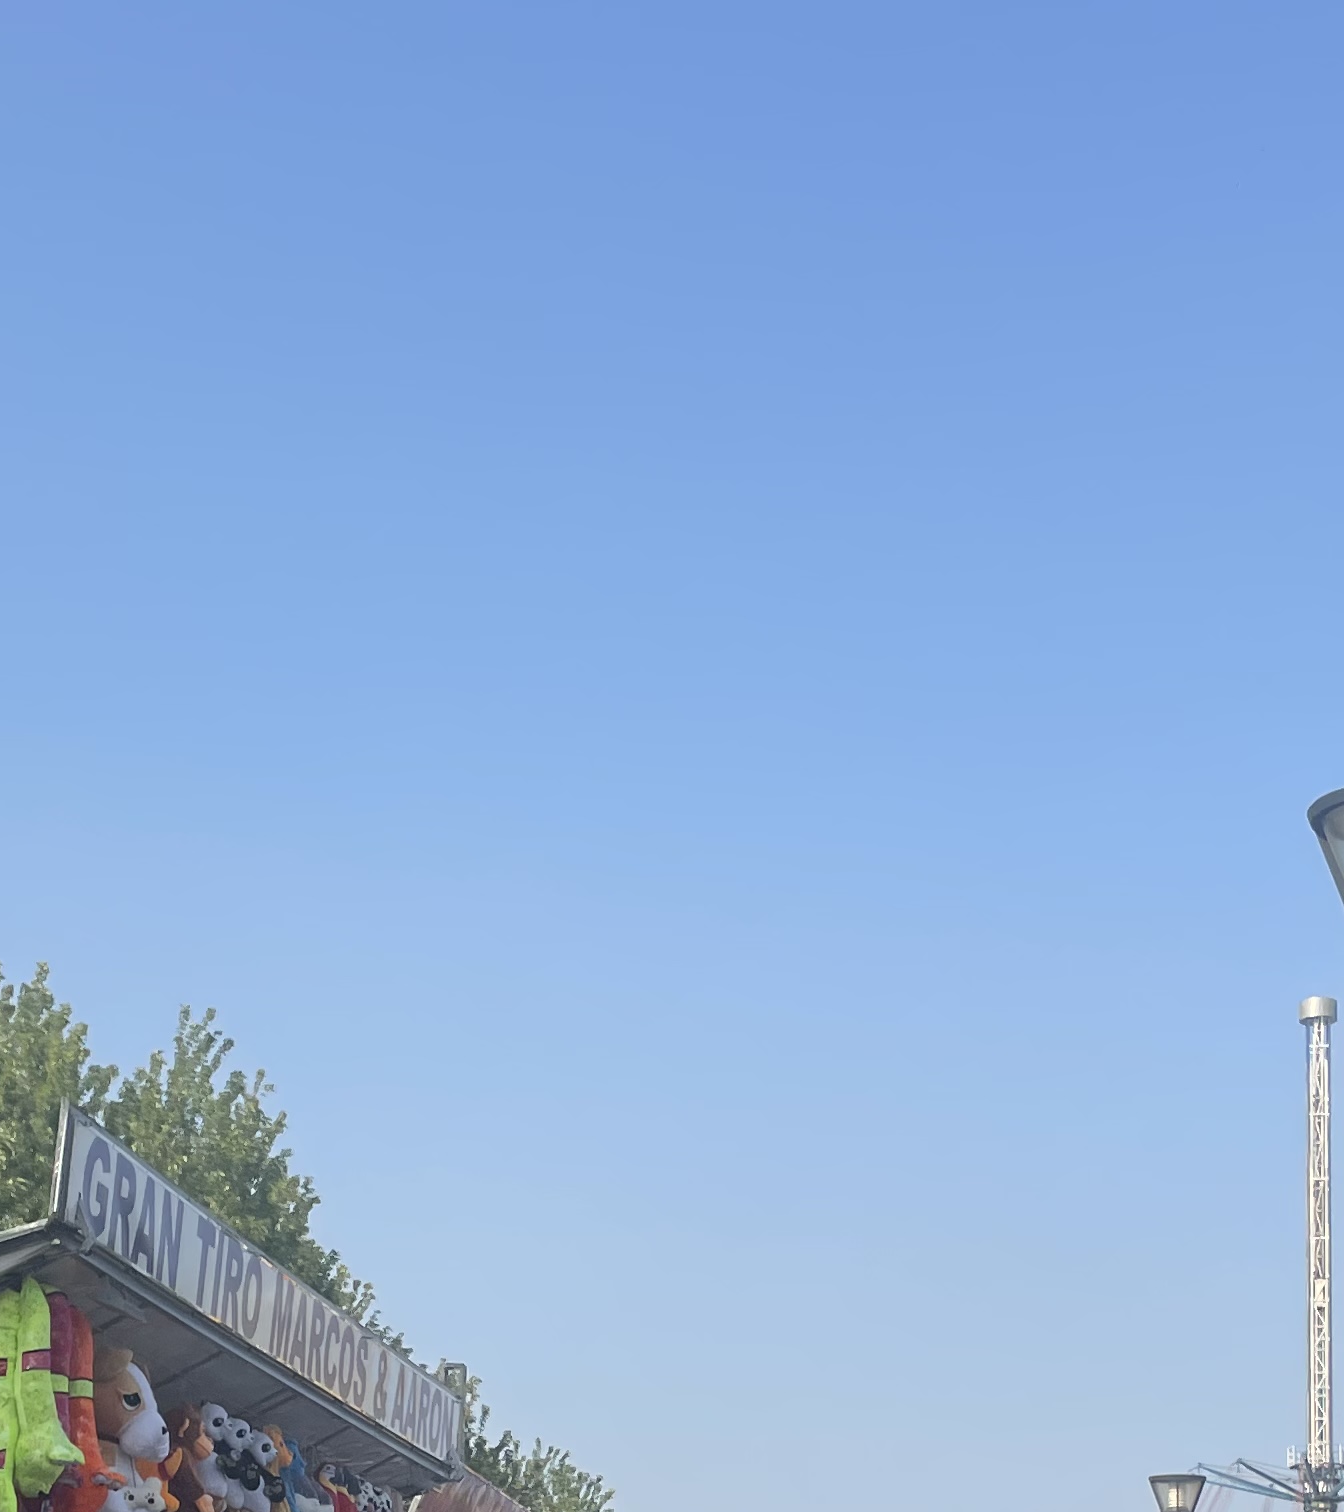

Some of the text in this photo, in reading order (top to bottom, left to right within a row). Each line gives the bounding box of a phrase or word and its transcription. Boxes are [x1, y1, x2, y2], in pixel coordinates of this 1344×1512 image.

[83, 1136, 455, 1456] GRAN TIRO MARCOS & AARON
